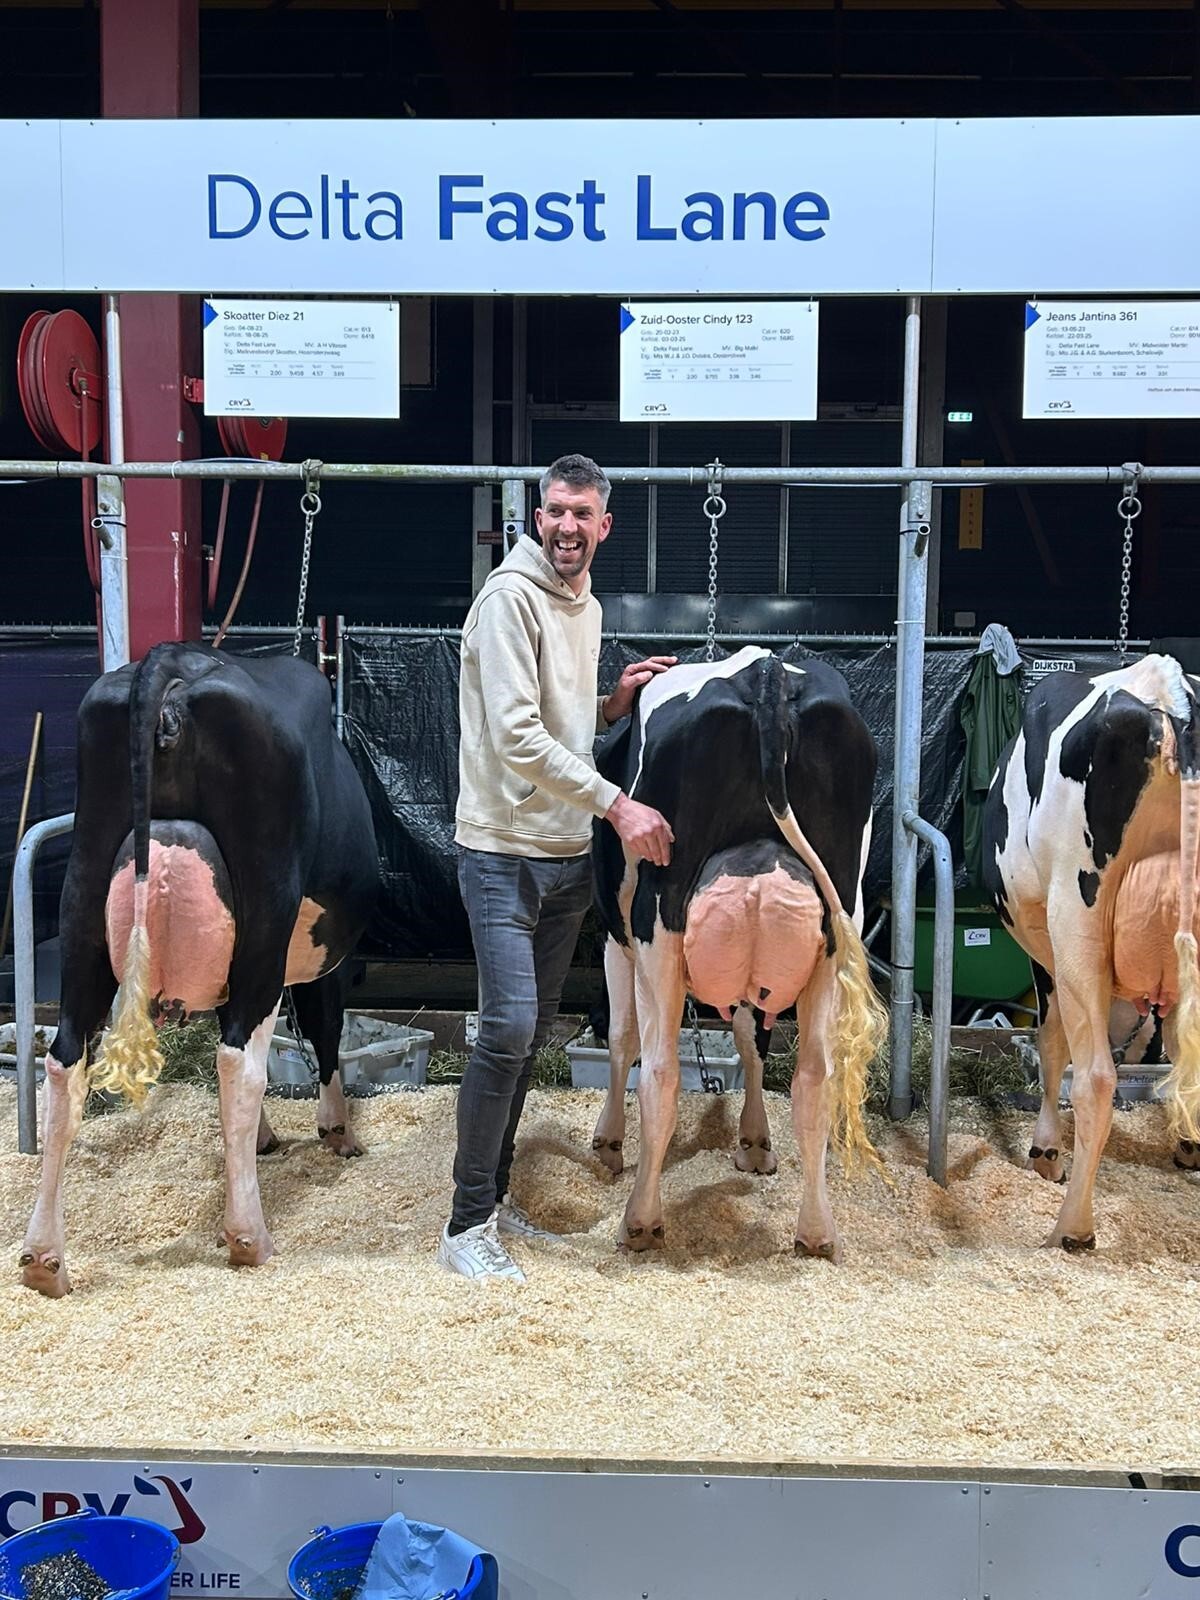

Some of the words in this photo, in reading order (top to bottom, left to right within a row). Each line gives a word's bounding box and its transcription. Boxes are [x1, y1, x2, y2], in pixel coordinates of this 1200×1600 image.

[208, 173, 403, 241] Delta
[438, 174, 606, 242] Fast
[636, 174, 831, 242] Lane
[223, 311, 265, 321] Skoatter
[268, 311, 290, 321] Diez
[293, 311, 304, 321] 21
[640, 315, 700, 325] Zuid-Ooster
[703, 315, 732, 326] Cindy
[736, 314, 753, 324] 123
[1046, 312, 1076, 321] Jeans
[1079, 312, 1116, 321] Jantina
[1119, 312, 1137, 321] 361
[1034, 661, 1074, 670] DIJKSTRA
[200, 1573, 241, 1589] LIFE
